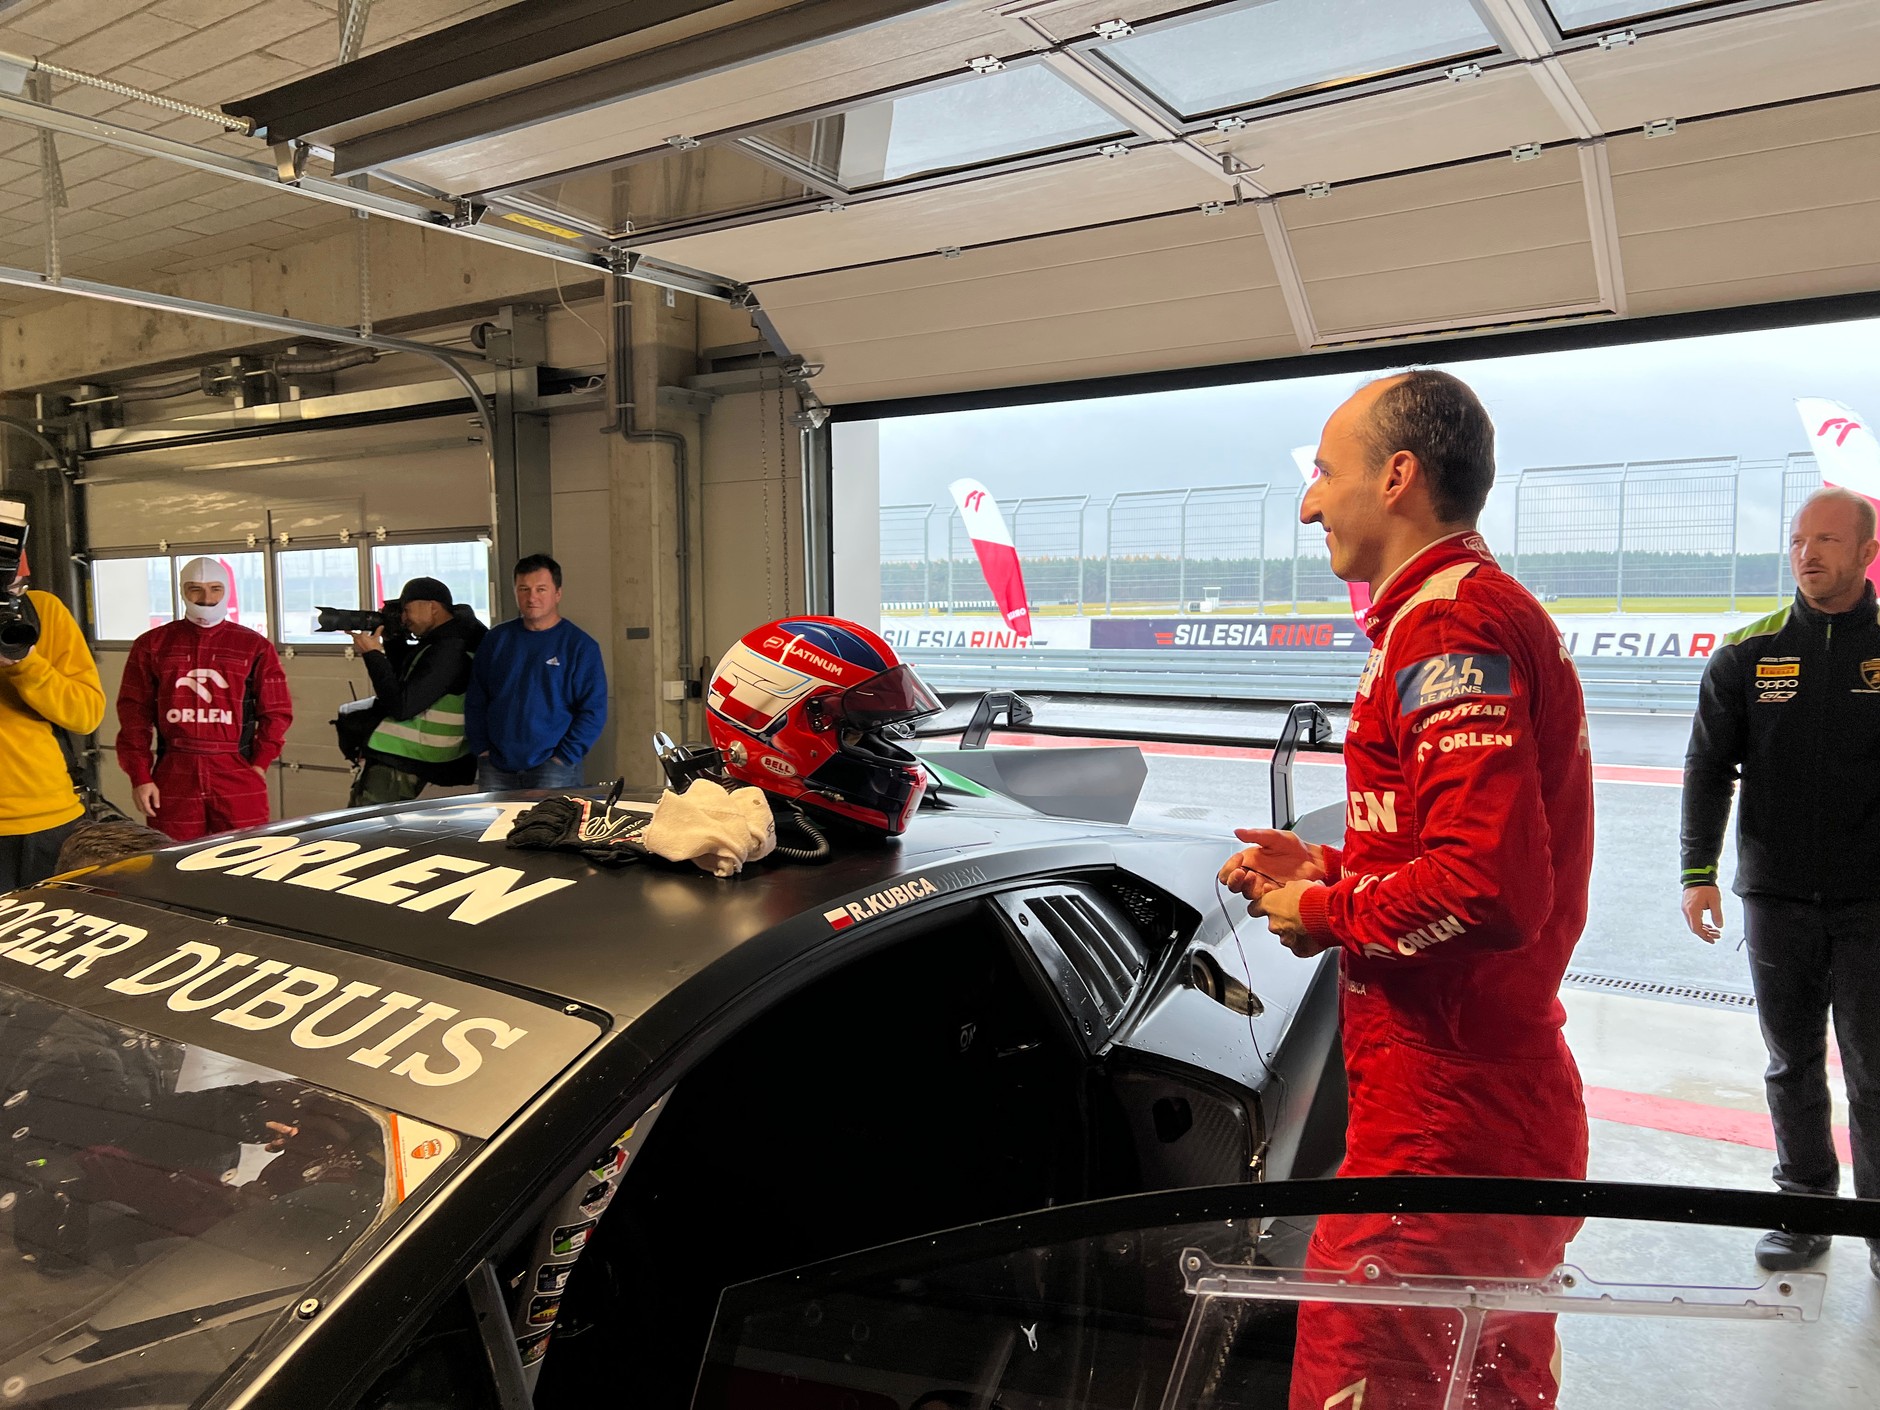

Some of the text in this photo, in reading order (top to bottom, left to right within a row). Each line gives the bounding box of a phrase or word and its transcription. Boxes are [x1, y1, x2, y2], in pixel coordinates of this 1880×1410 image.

[1174, 623, 1334, 647] SILESIARING
[1420, 692, 1438, 706] LE
[166, 708, 233, 725] ORLEN
[1411, 702, 1507, 735] GOODYEAR
[1438, 732, 1513, 753] ORLEN
[764, 757, 792, 774] BELL
[1347, 790, 1398, 833] EN
[176, 836, 577, 926] ORLEN
[846, 877, 938, 922] R.KUBICA
[1397, 915, 1466, 955] ORLEN
[103, 940, 527, 1087] DUBUIS
